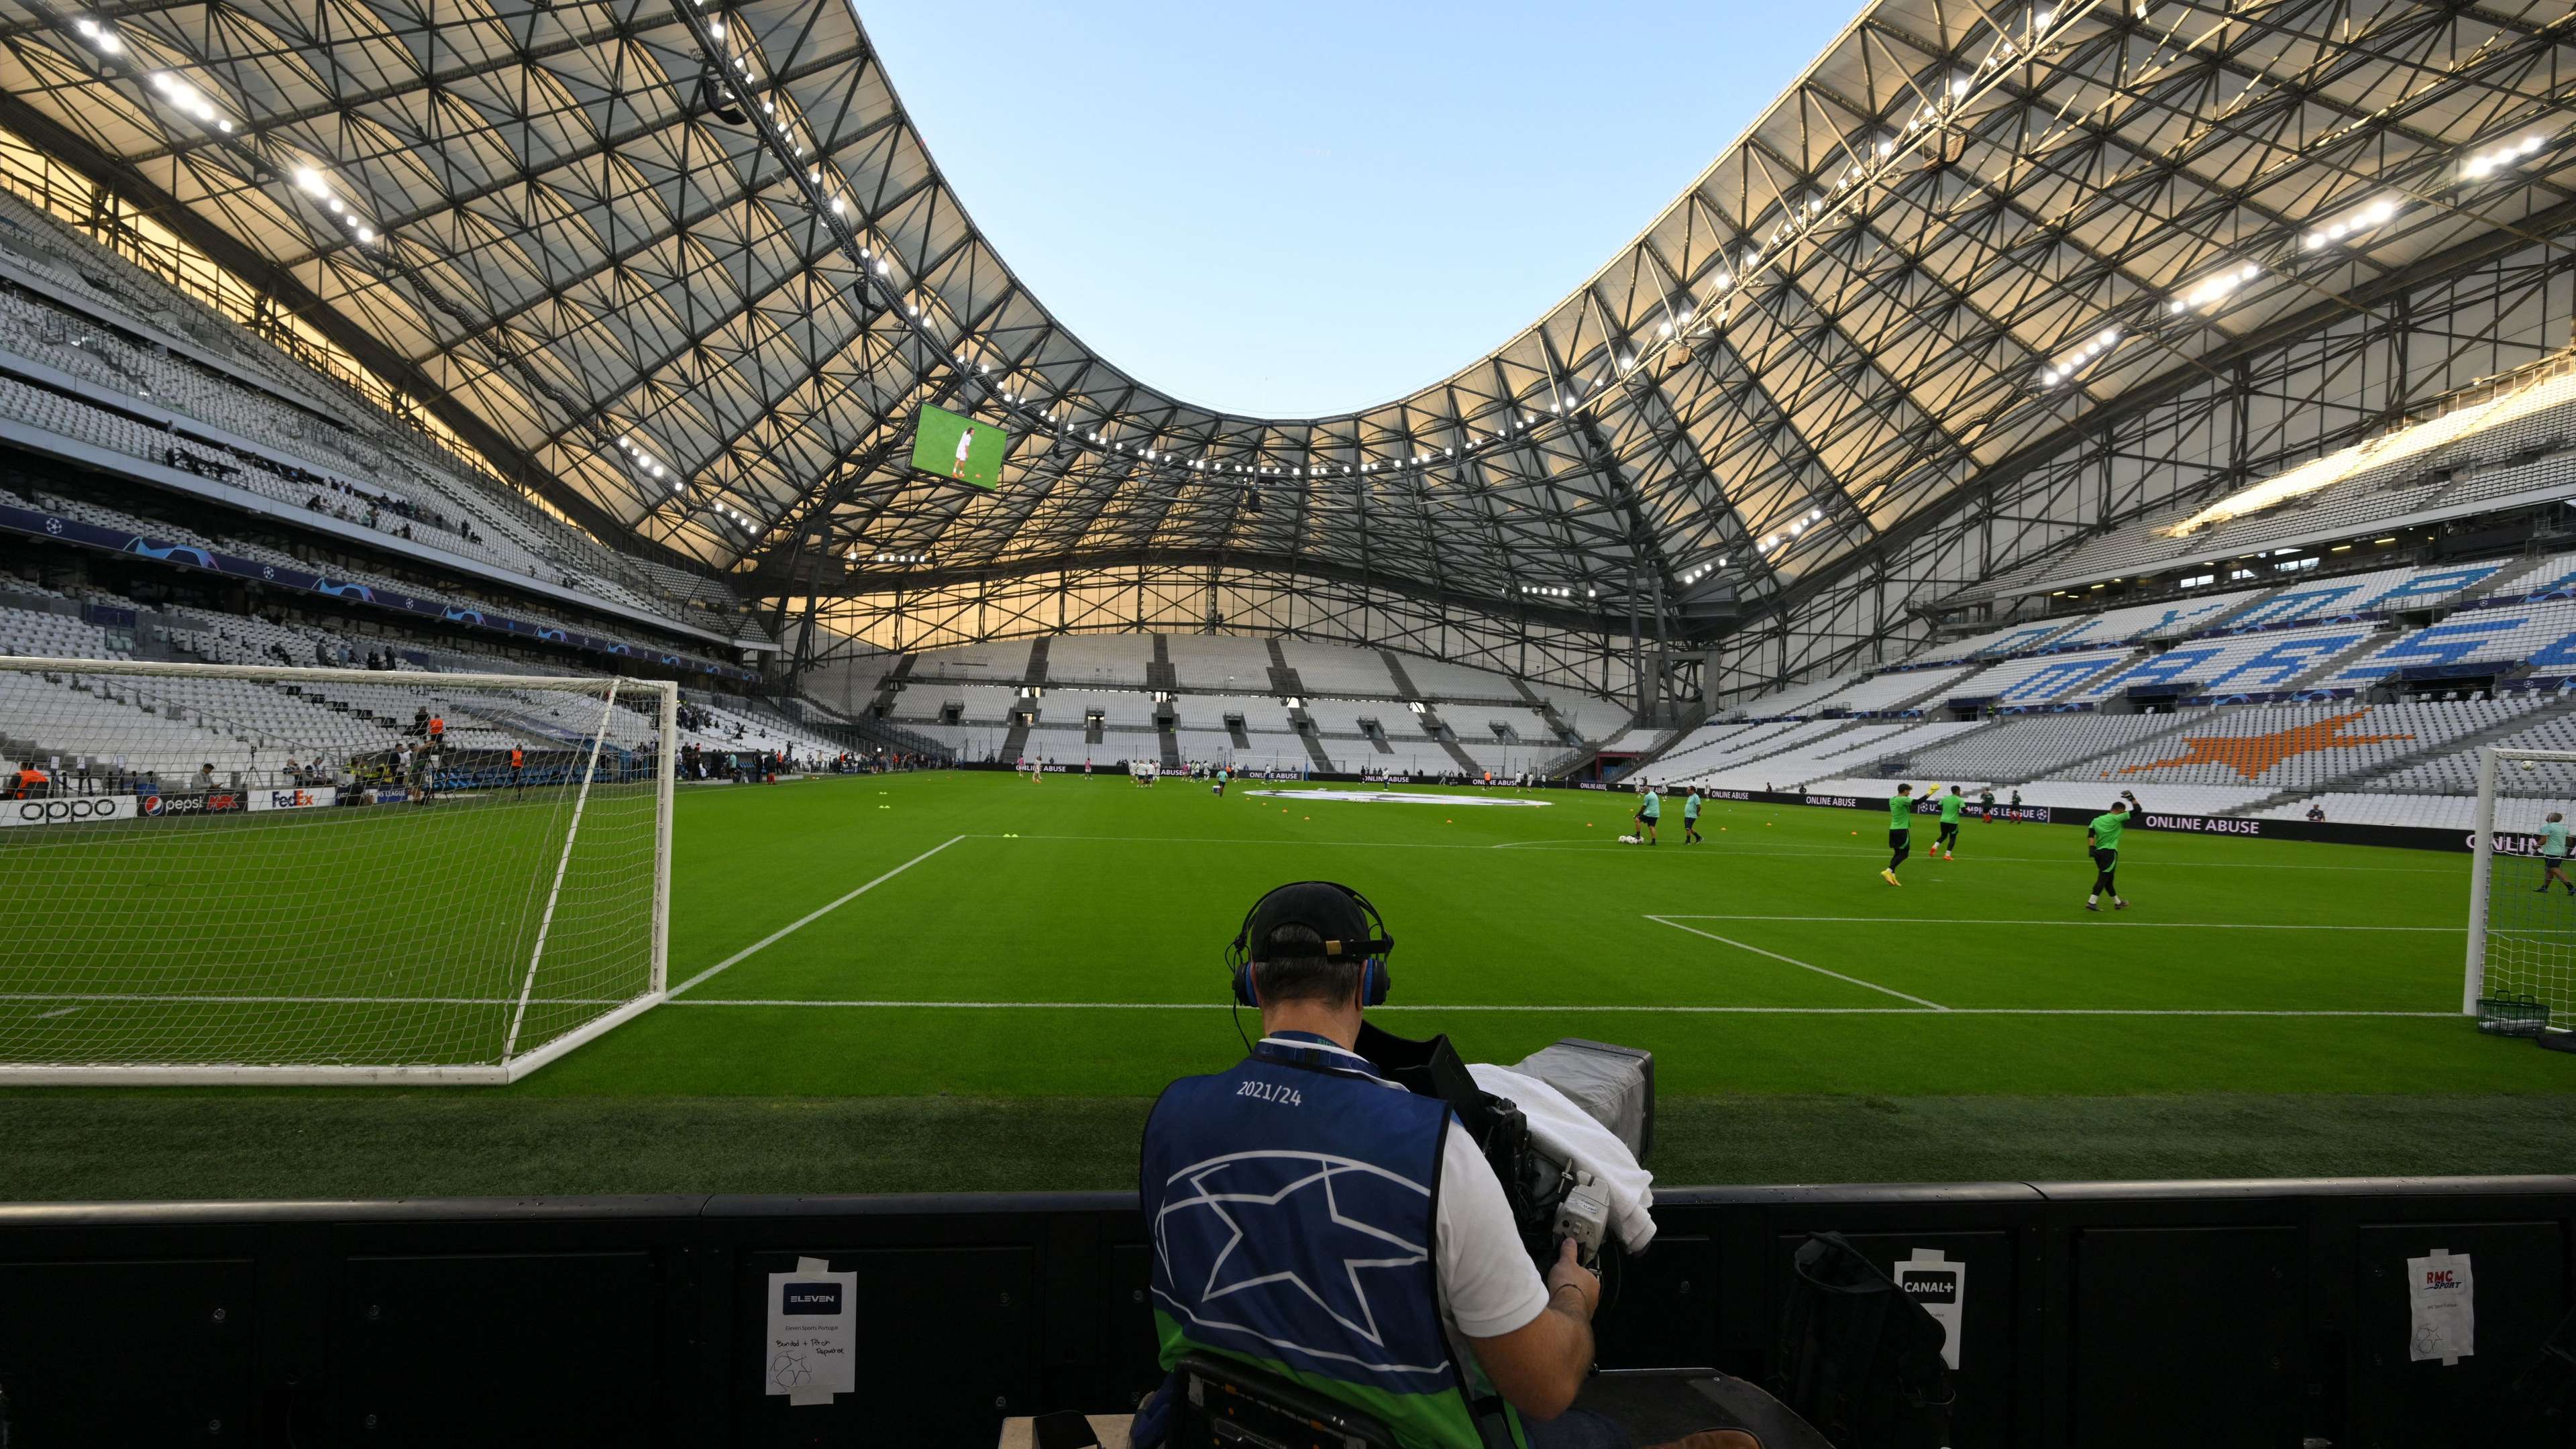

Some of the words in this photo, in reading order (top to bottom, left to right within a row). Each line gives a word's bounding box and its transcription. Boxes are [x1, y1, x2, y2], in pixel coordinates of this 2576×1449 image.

[272, 789, 314, 808] FedEx
[1711, 790, 1730, 799] ONLINE
[1731, 792, 1749, 800] ABUSE
[1806, 796, 1831, 806] ONLINE
[1832, 798, 1856, 807] ABUSE
[20, 798, 116, 824] oppo
[166, 797, 204, 814] pepsi
[2146, 815, 2201, 830] ONLINE
[2205, 819, 2259, 835] ABUSE
[2465, 834, 2544, 854] ONLIN
[1236, 1081, 1301, 1106] 2021/24
[2426, 1270, 2453, 1284] RMC
[2433, 1281, 2461, 1289] SPORT
[1904, 1281, 1954, 1293] CANAL+
